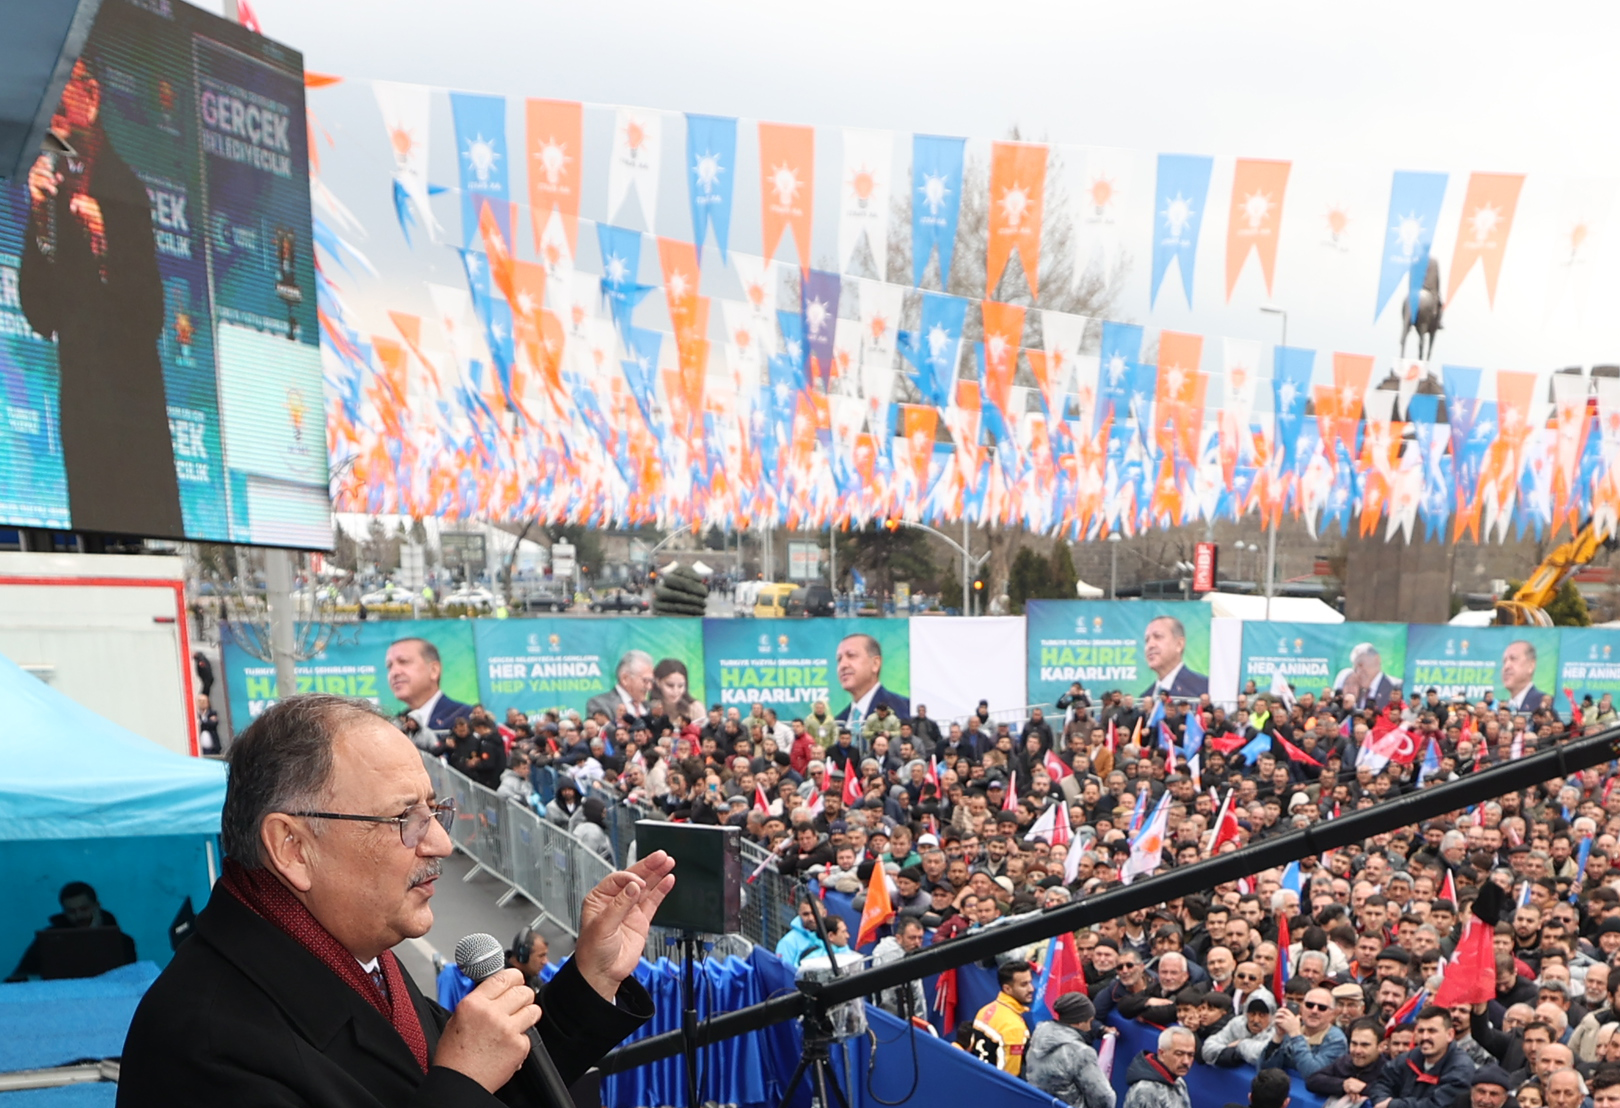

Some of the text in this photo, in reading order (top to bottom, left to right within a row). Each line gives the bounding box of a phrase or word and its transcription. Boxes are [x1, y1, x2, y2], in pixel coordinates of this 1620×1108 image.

[201, 90, 291, 154] GERÇEK
[1041, 647, 1137, 666] HAZIRIZ
[489, 662, 601, 679] HER ANINDA
[720, 667, 828, 687] HAZIRIZ
[1041, 666, 1137, 681] KARARLIYIZ
[1247, 662, 1329, 676] HER ANINDA
[1414, 667, 1495, 683] HAZIRIZ
[1563, 667, 1586, 679] HER
[491, 678, 603, 693] HEP YANINDA
[721, 688, 829, 704] KARARLIYIZ
